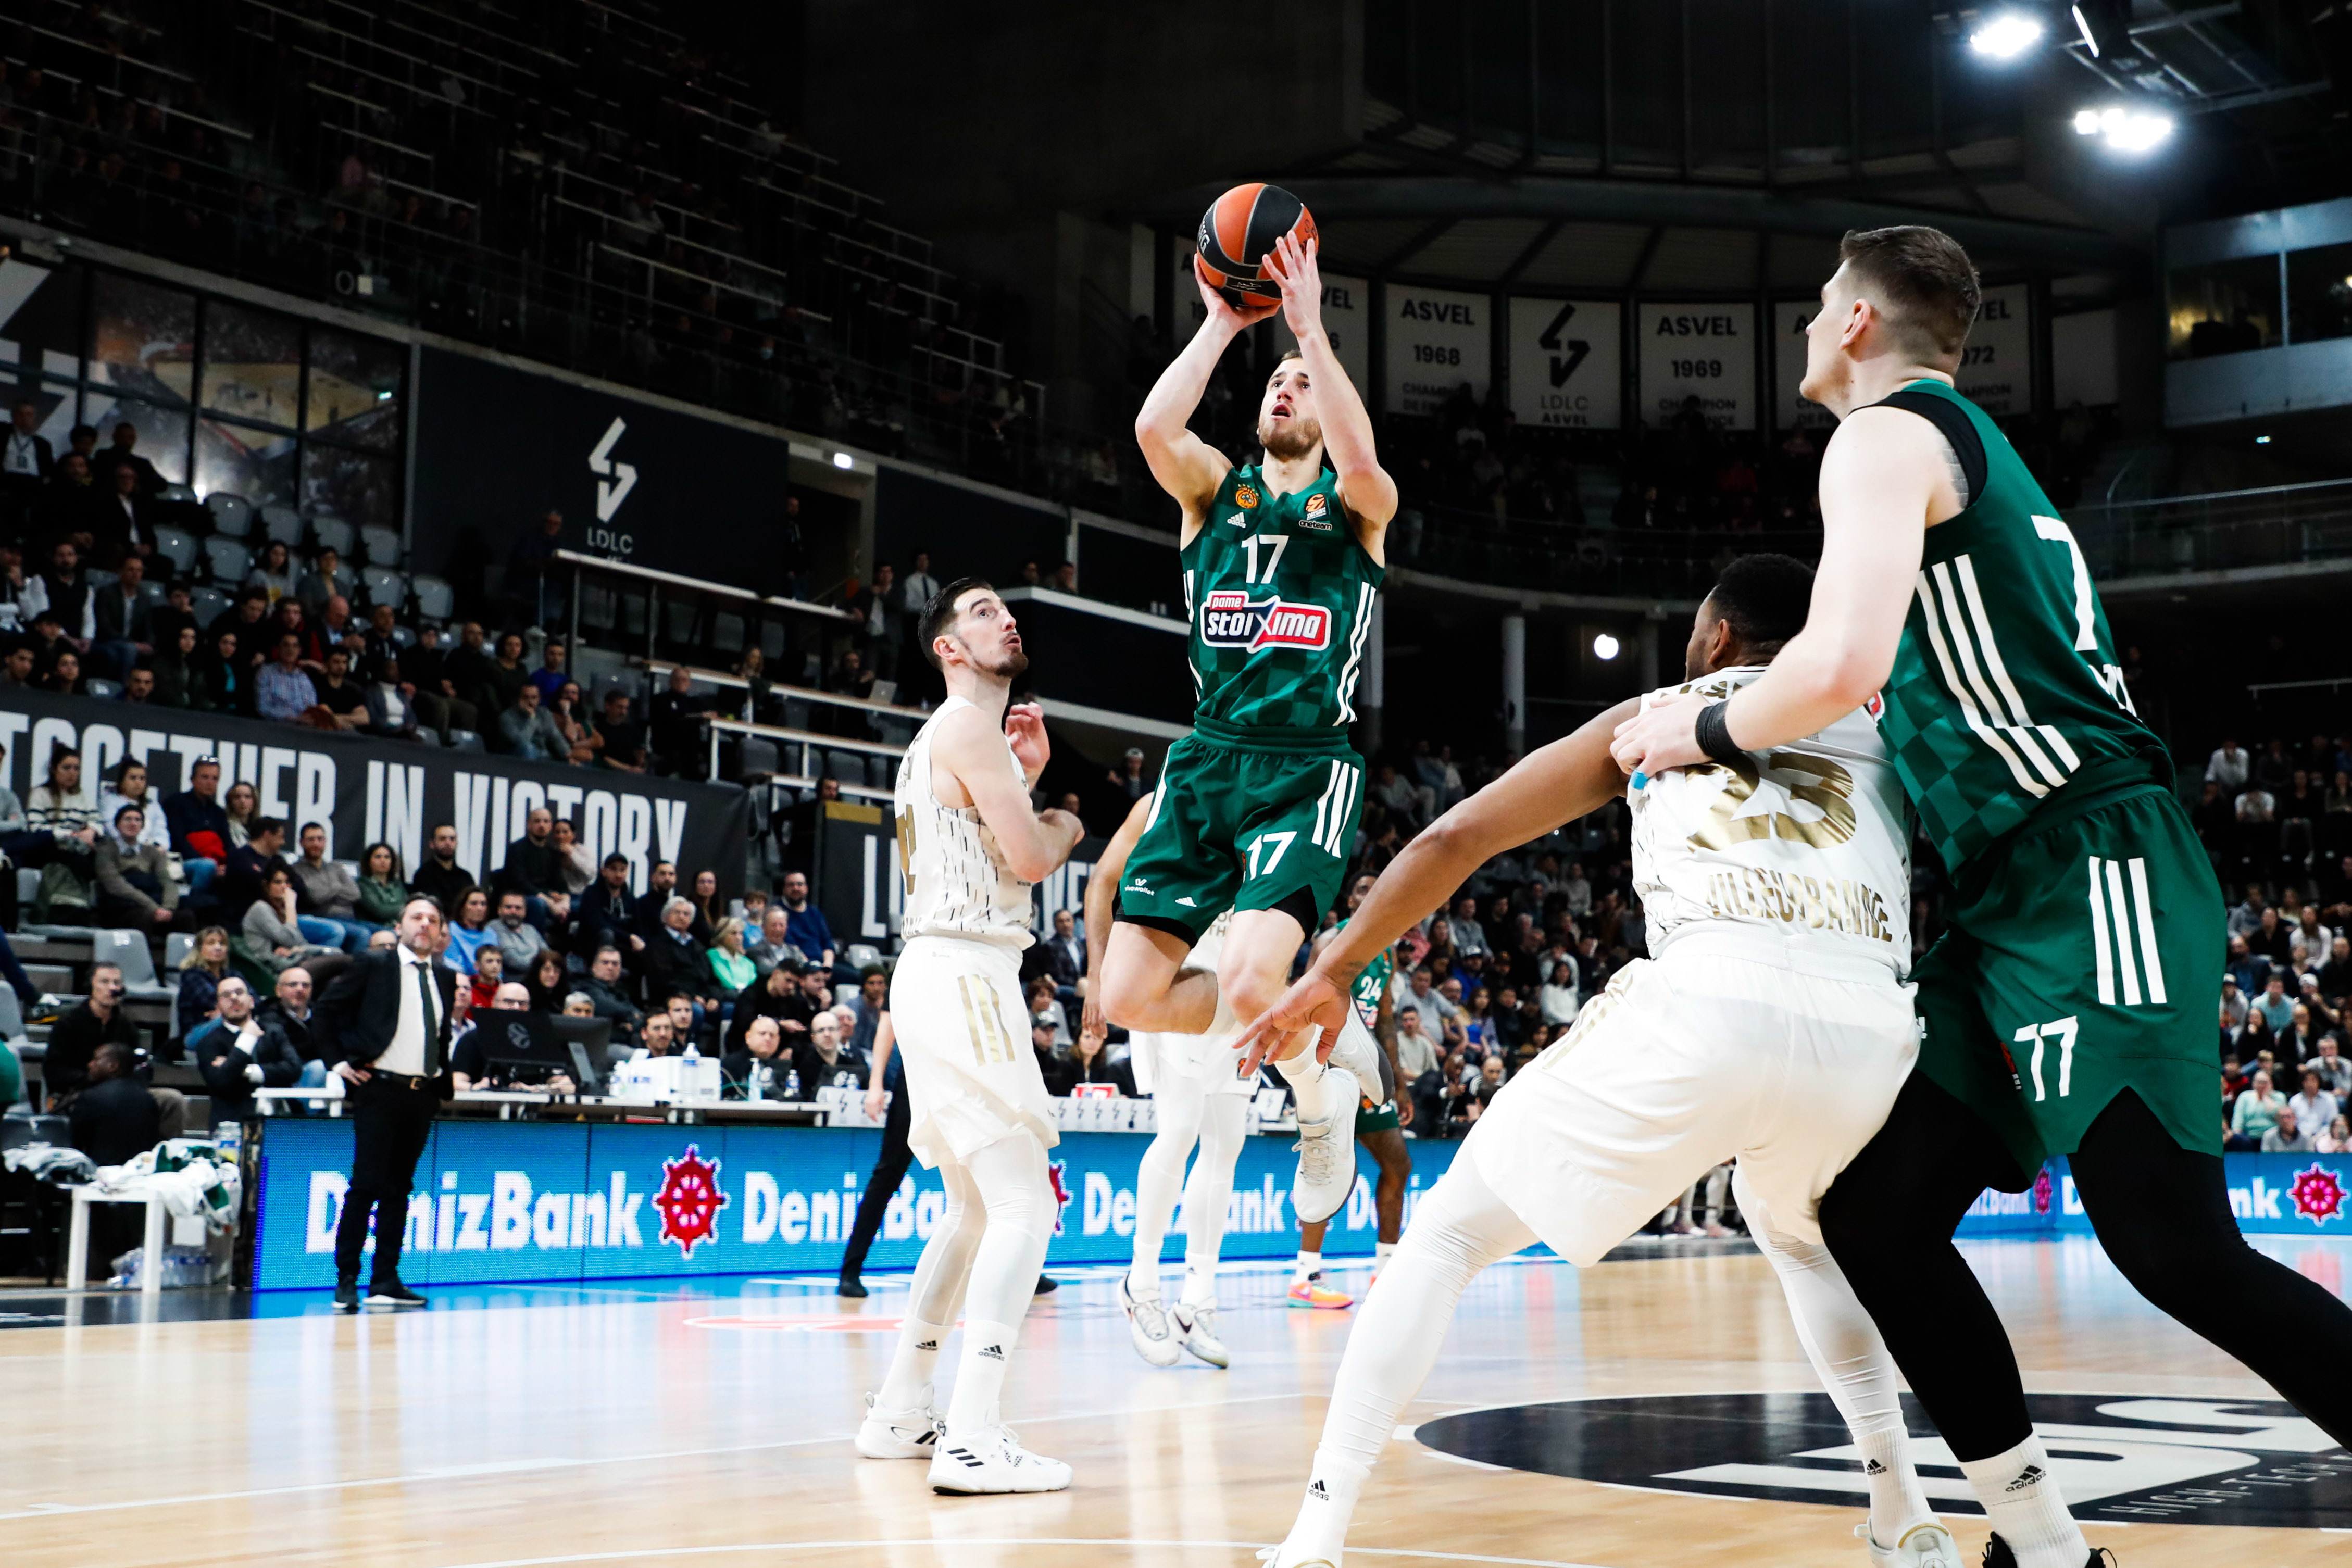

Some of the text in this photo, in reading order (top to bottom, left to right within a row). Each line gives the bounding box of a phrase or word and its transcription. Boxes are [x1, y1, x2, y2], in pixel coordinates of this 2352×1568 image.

[1402, 299, 1474, 325] ASVEL
[1657, 316, 1736, 335] ASVEL
[1415, 345, 1460, 365] 1968
[1673, 360, 1722, 378] 1969
[1541, 395, 1588, 411] LDLC
[1543, 413, 1587, 425] ASVEL
[586, 525, 634, 555] LDLC
[1241, 534, 1289, 584] 17
[1212, 596, 1242, 609] pame
[364, 760, 425, 885] IN
[454, 771, 687, 898] VICTORY
[1247, 831, 1297, 881] 17
[1358, 975, 1382, 1001] 24
[306, 1170, 643, 1254] DnizBank
[742, 1171, 946, 1244] DeniBa
[2005, 1470, 2046, 1492] adidas
